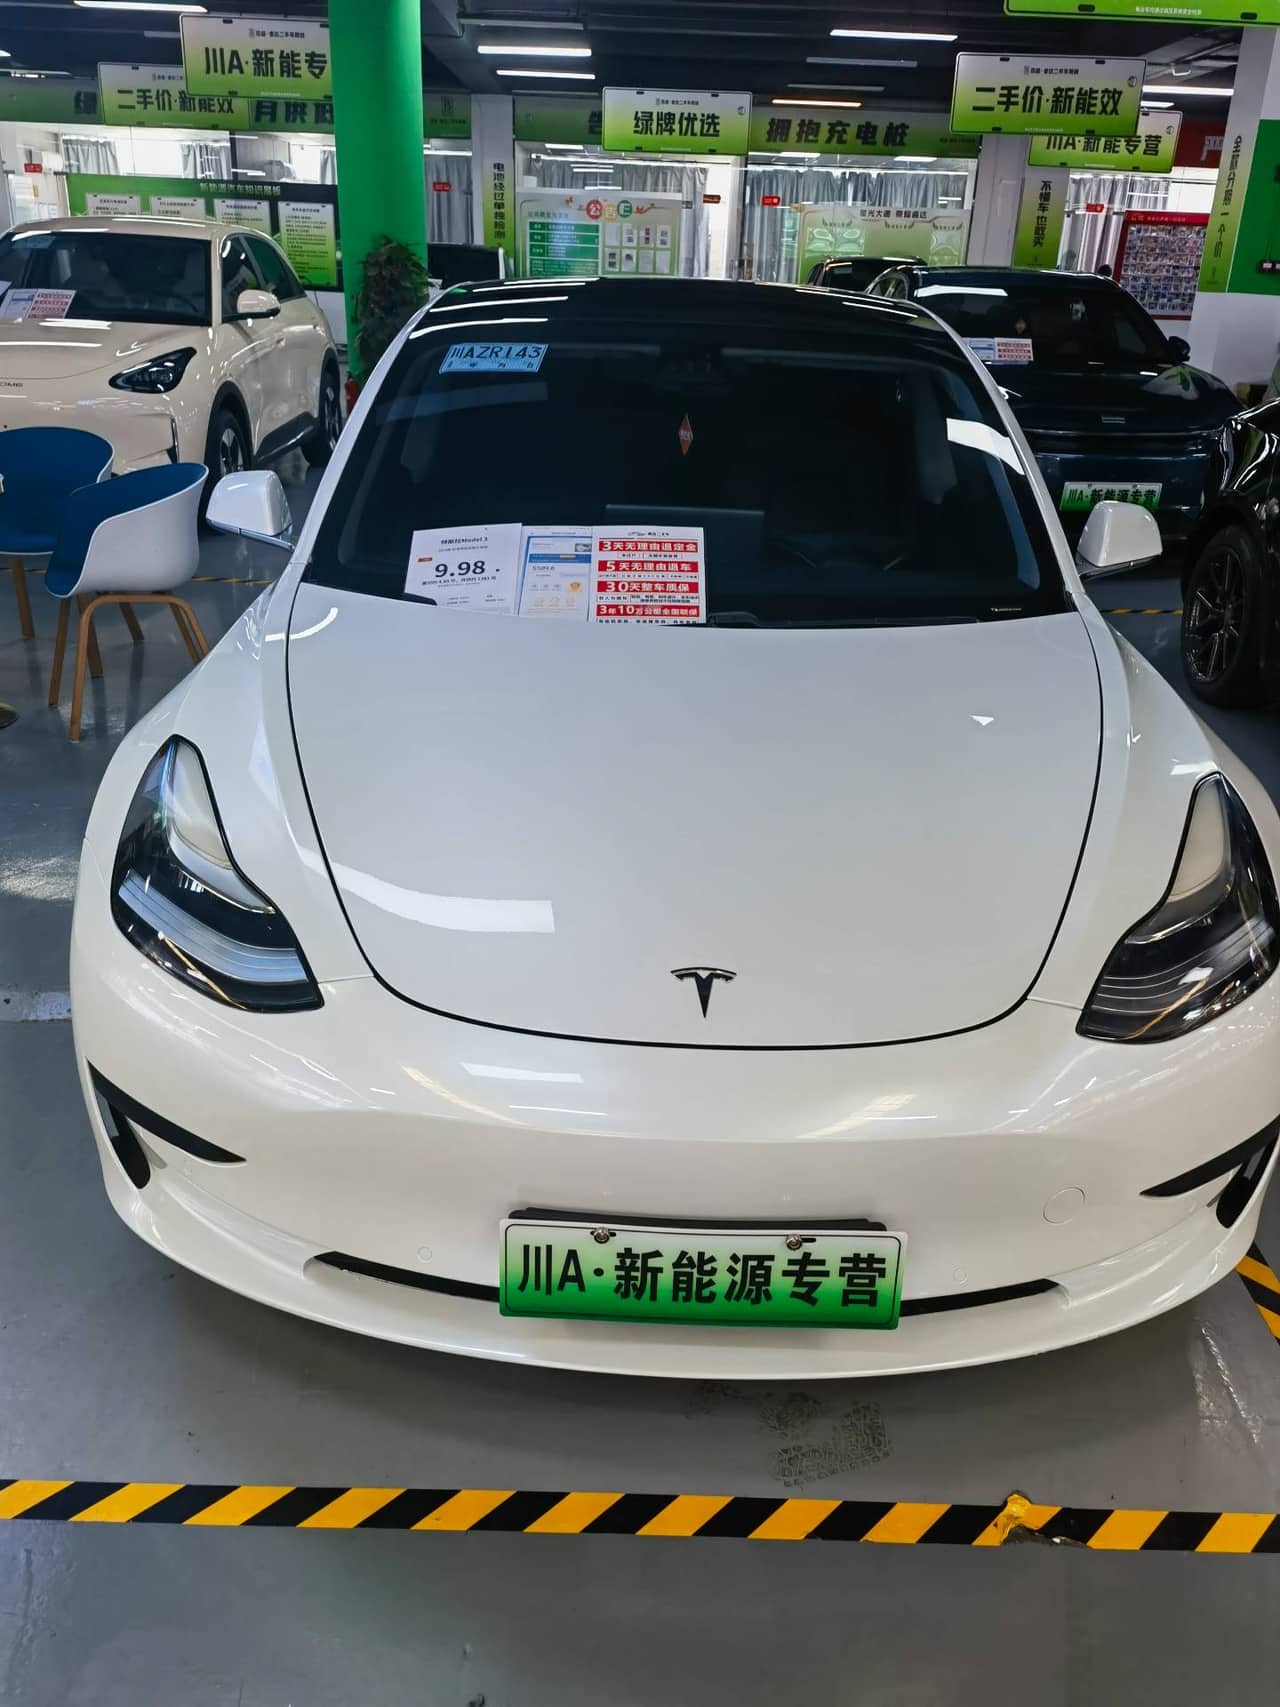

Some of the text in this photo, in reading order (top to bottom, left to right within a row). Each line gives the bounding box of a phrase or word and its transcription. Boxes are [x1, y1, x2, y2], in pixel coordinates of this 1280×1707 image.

[972, 85, 1122, 116] 二手价·新能效
[633, 110, 720, 137] 绿牌优选
[766, 118, 910, 146] 拥抱充电桩
[435, 561, 485, 578] 9.98
[606, 581, 690, 592] 30天整车质保
[518, 1244, 887, 1307] 川A·新能源专营
